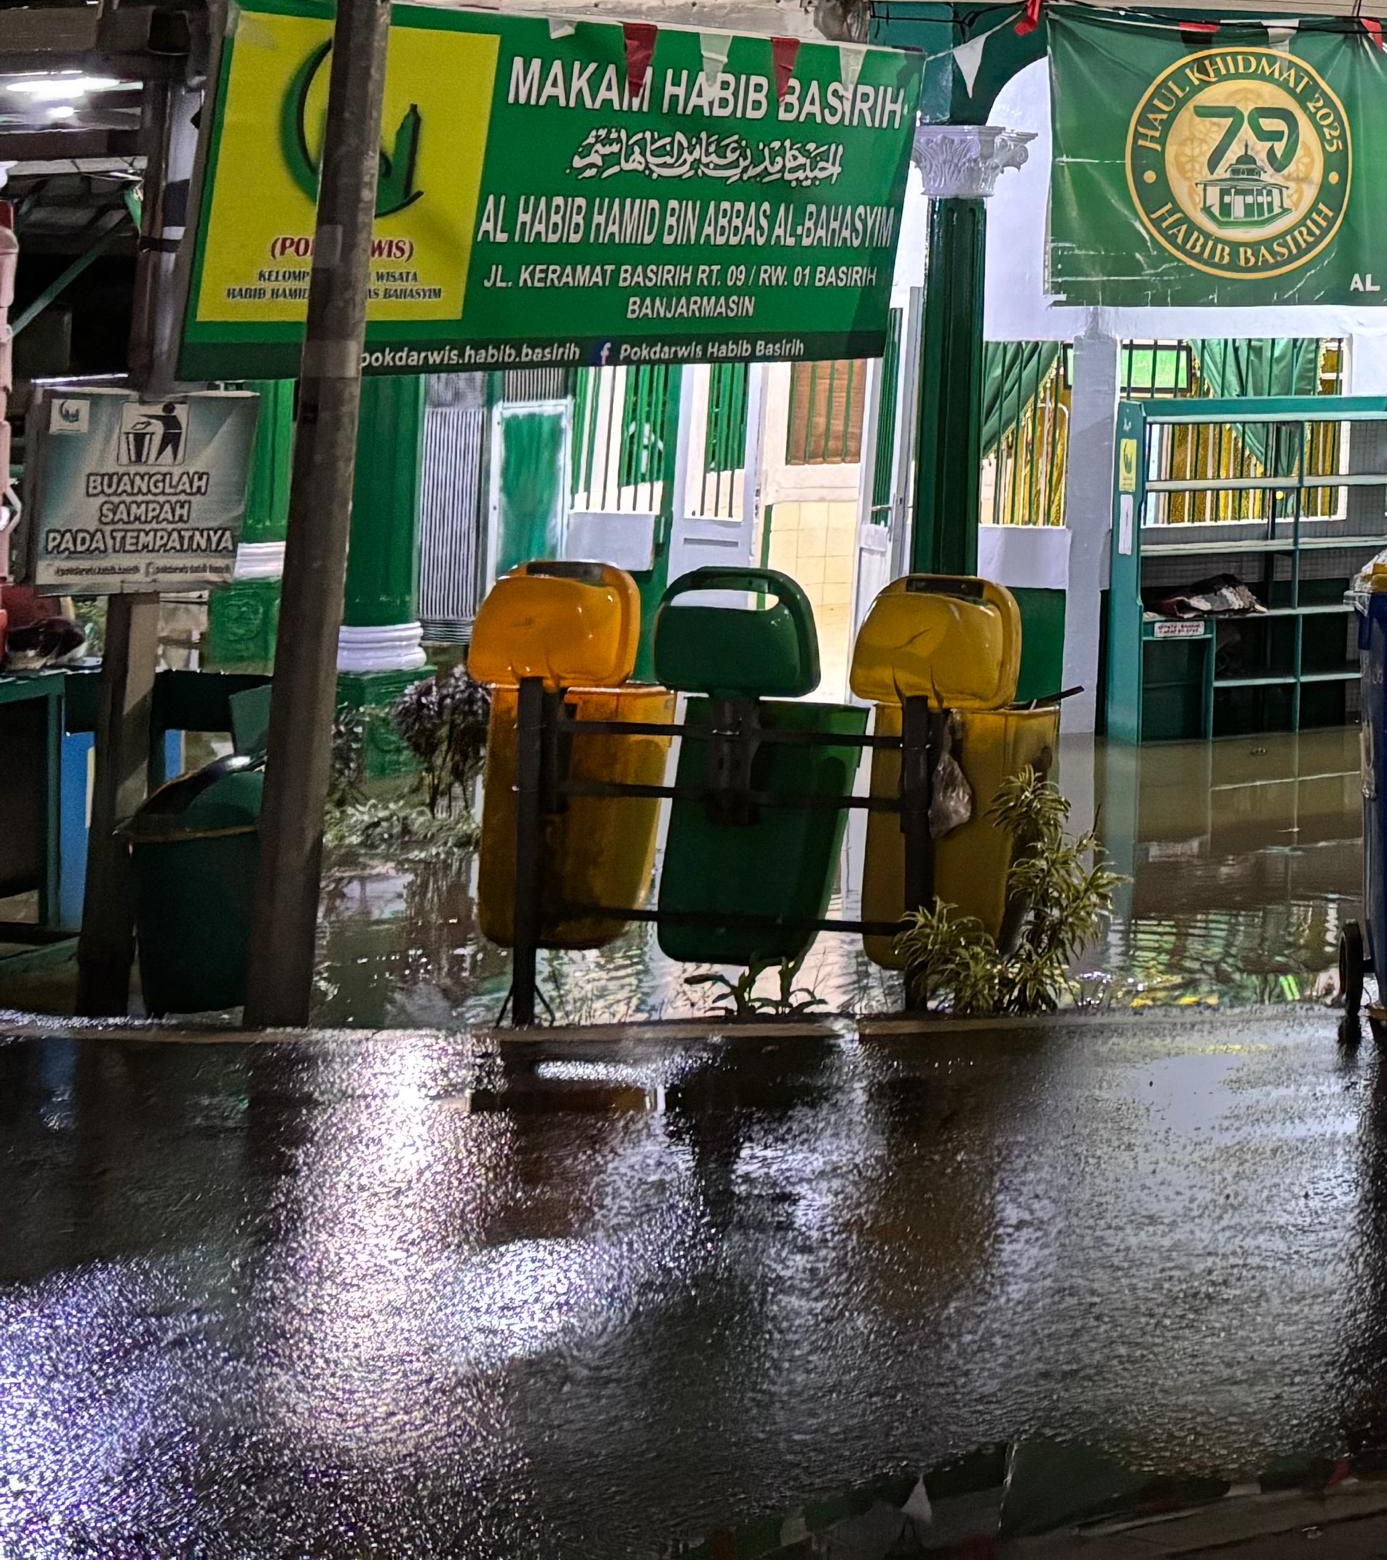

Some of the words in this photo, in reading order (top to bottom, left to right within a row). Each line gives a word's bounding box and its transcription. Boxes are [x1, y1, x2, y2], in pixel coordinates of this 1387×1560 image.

[507, 56, 651, 113] MAKAM
[662, 68, 769, 120] HABIB
[777, 79, 906, 130] BASIRIH
[1137, 82, 1190, 153] HAUL
[1186, 55, 1313, 95] KHIDMAT
[1306, 91, 1344, 154] 2025
[477, 196, 509, 243] AL
[514, 197, 587, 245] HABIB
[593, 198, 660, 246] HAMID
[664, 200, 698, 246] BIN
[701, 200, 770, 248] ABBAS
[772, 203, 896, 249] AL-BAHASYIM
[1150, 201, 1231, 266] HABIB
[1238, 202, 1335, 268] BASIRIH
[271, 237, 414, 263] (POWIS)
[258, 270, 310, 283] KELOMP
[376, 271, 418, 283] WISATA
[484, 265, 513, 288] JL.
[518, 265, 615, 288] KERAMAT
[619, 265, 691, 287] BASIRIH
[696, 265, 721, 287] RT.
[726, 265, 745, 287] 09
[759, 266, 788, 287] RW.
[793, 266, 810, 287] 01
[815, 266, 877, 287] BASIRIH
[1350, 273, 1380, 291] AL
[626, 295, 756, 320] BANJARMASIN
[620, 342, 702, 361] Pokdarwis
[707, 340, 752, 358] Habib
[756, 338, 805, 357] Basirih
[86, 471, 209, 497] BUANGLAH
[99, 500, 191, 525] SAMPAH
[46, 530, 105, 554] PADA
[112, 529, 234, 554] TEMPATNYA
